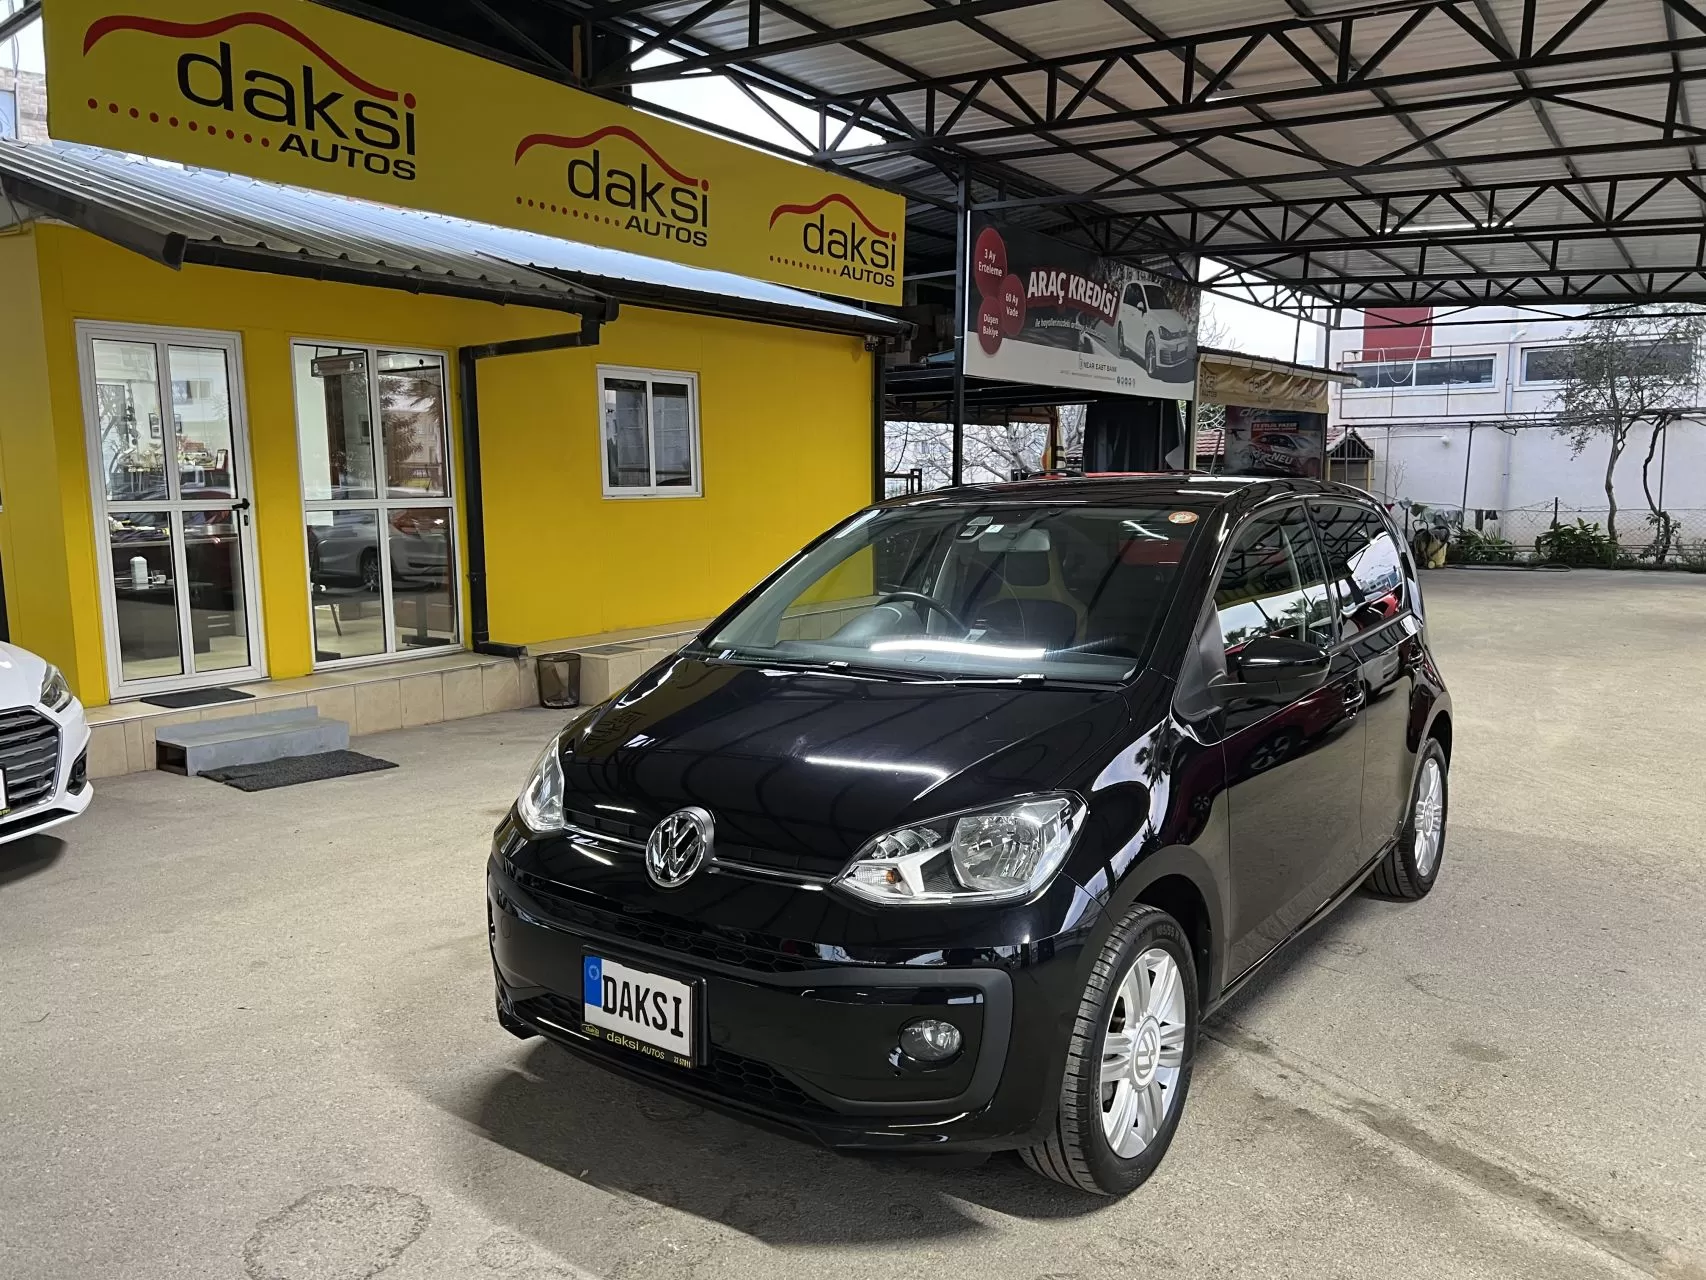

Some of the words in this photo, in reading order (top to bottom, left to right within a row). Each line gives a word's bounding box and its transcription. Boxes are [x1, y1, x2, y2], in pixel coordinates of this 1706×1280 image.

[176, 41, 417, 156] daksi
[278, 133, 417, 181] AUTOS
[567, 149, 710, 228] daksi
[624, 215, 708, 248] AUTOS
[802, 213, 898, 272] daksi
[984, 248, 988, 259] 3
[988, 250, 996, 263] Ay
[839, 264, 895, 288] AUTOS
[978, 261, 1003, 277] Erteleme
[1005, 292, 1012, 303] 60
[1012, 294, 1019, 307] Ay
[1027, 270, 1067, 305] ARAÇ
[1068, 274, 1118, 318] KREDİSİ
[1006, 306, 1018, 317] Vade
[982, 326, 999, 338] Bakiye
[1083, 361, 1095, 369] NEAR
[1095, 363, 1106, 371] EAST
[1271, 452, 1294, 465] NEU
[602, 974, 684, 1039] DAKSI
[606, 1031, 640, 1051] daksi
[641, 1045, 665, 1060] AUTOS
